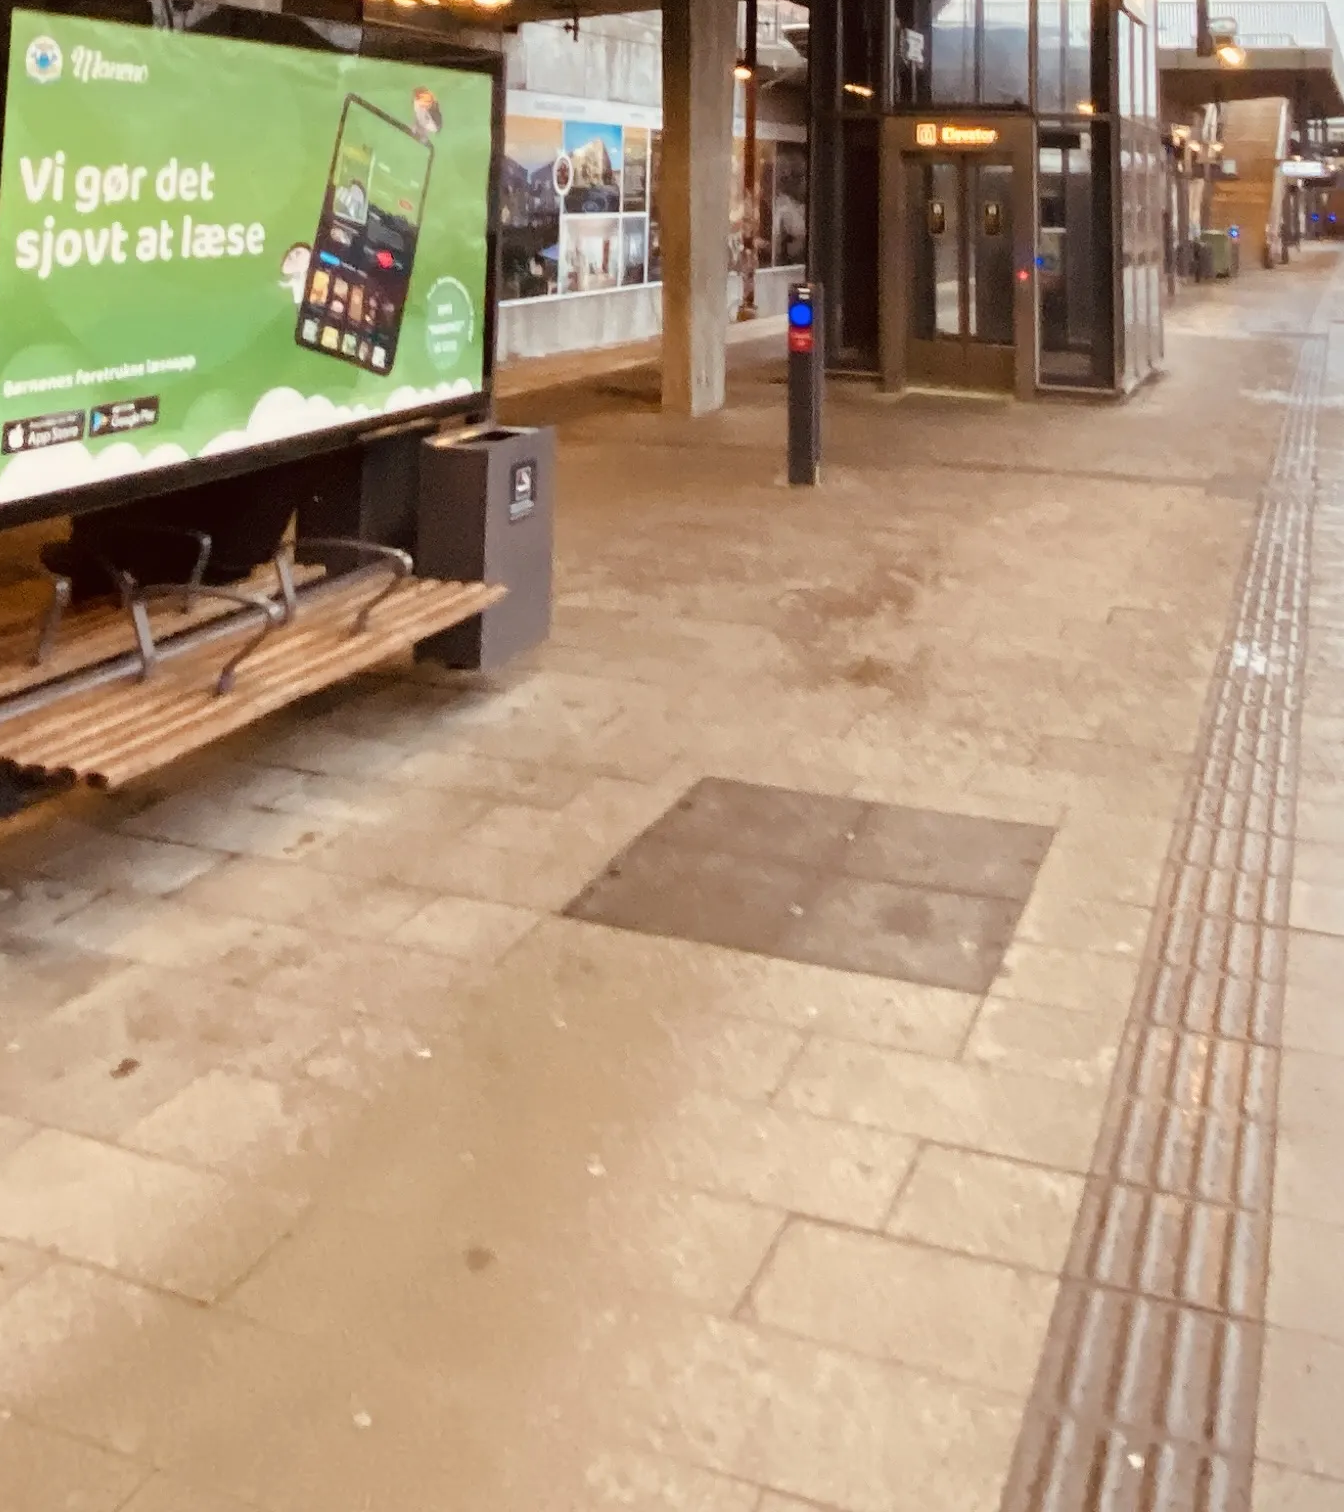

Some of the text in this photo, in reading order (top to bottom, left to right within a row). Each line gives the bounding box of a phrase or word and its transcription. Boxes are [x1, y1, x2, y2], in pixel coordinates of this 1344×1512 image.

[19, 150, 216, 213] Vi gør det
[15, 214, 266, 279] sjovt at læse
[28, 431, 52, 448] App
